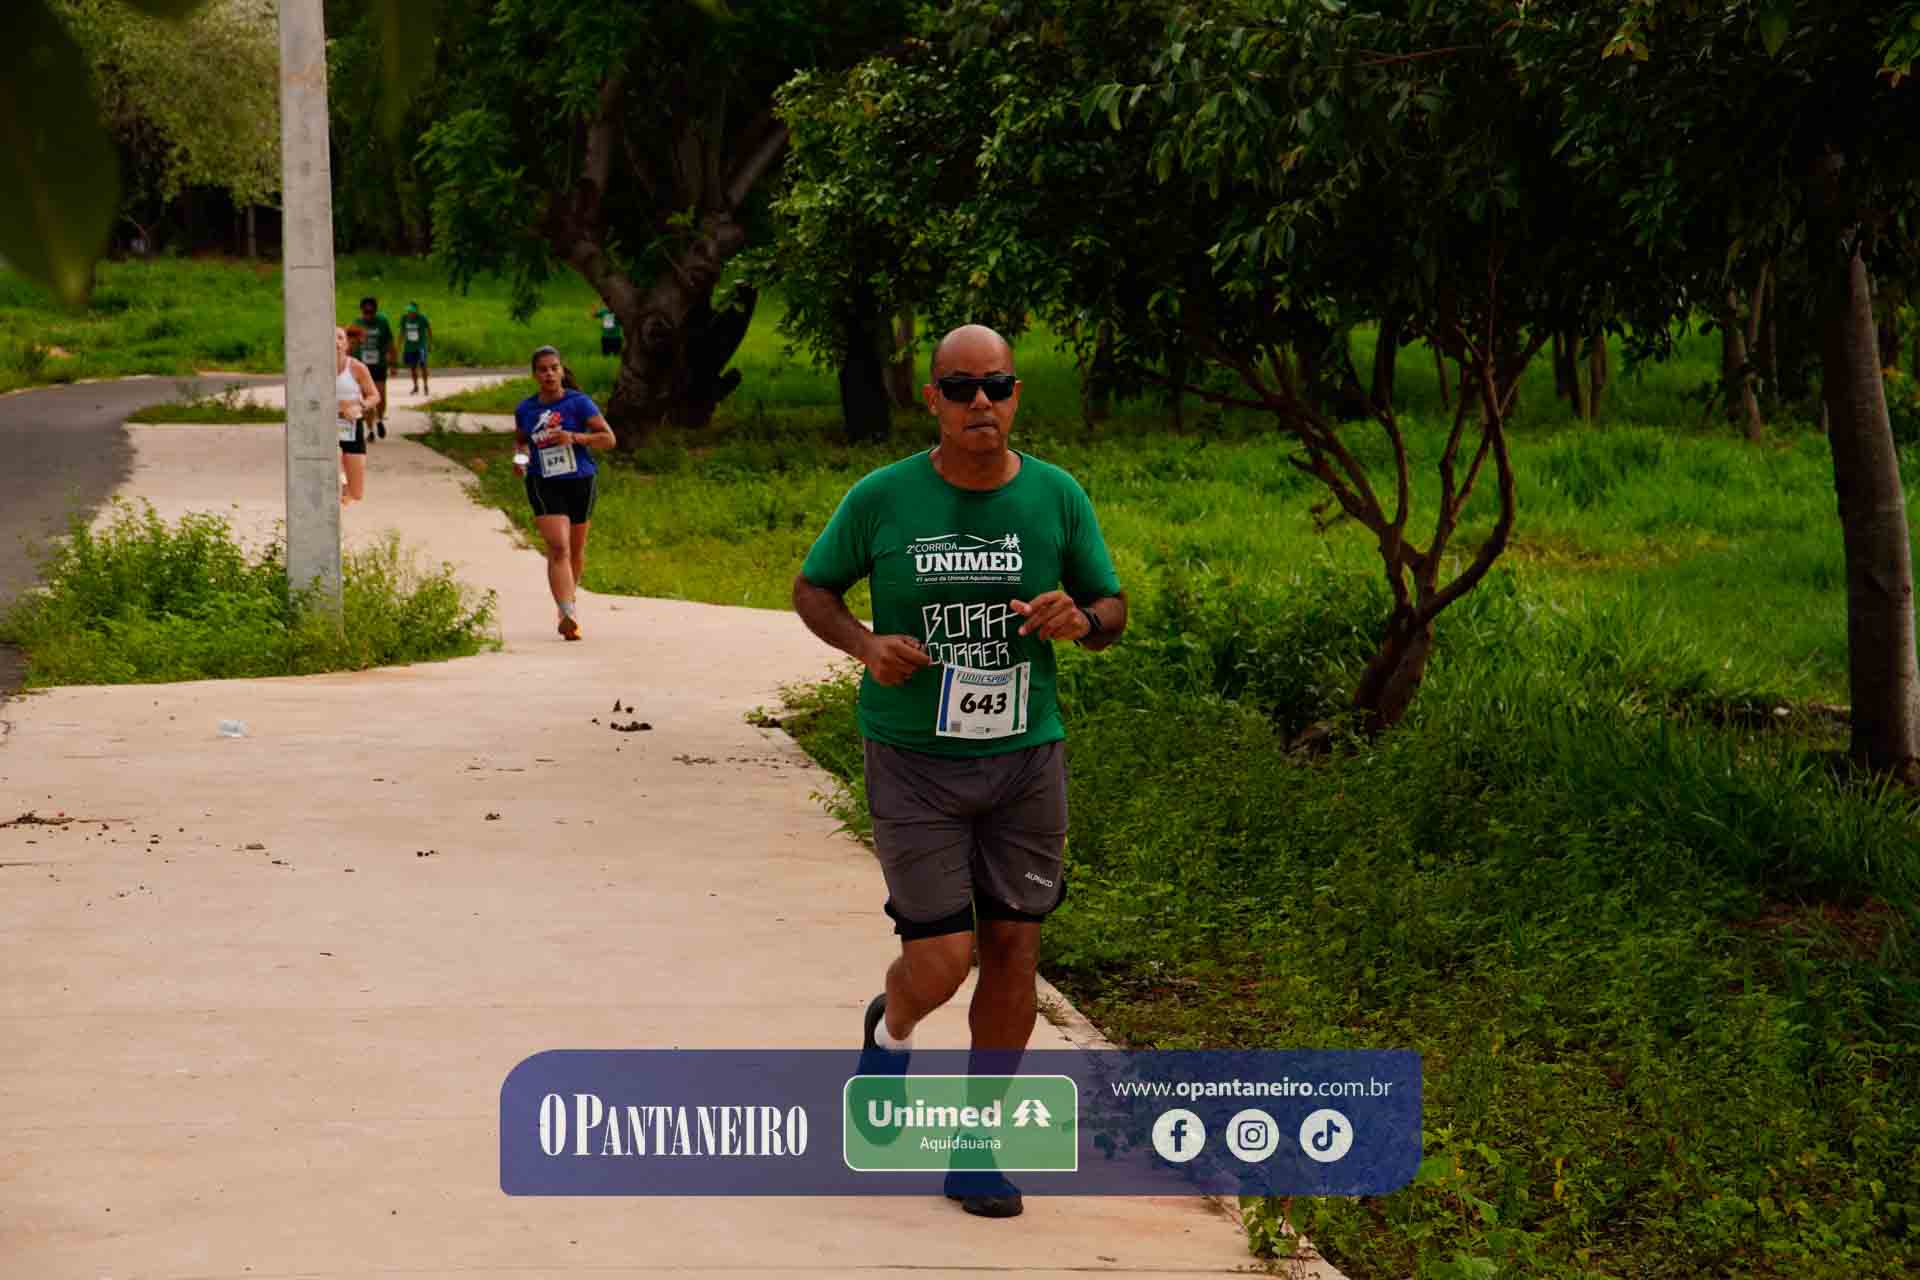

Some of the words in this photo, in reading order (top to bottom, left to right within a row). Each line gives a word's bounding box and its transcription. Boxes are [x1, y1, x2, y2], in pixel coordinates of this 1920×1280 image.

[915, 543, 958, 553] CORRIDA
[915, 552, 1023, 573] UNIMED
[921, 602, 1019, 643] BORA
[927, 640, 1010, 668] CORRER
[960, 692, 1007, 715] 643
